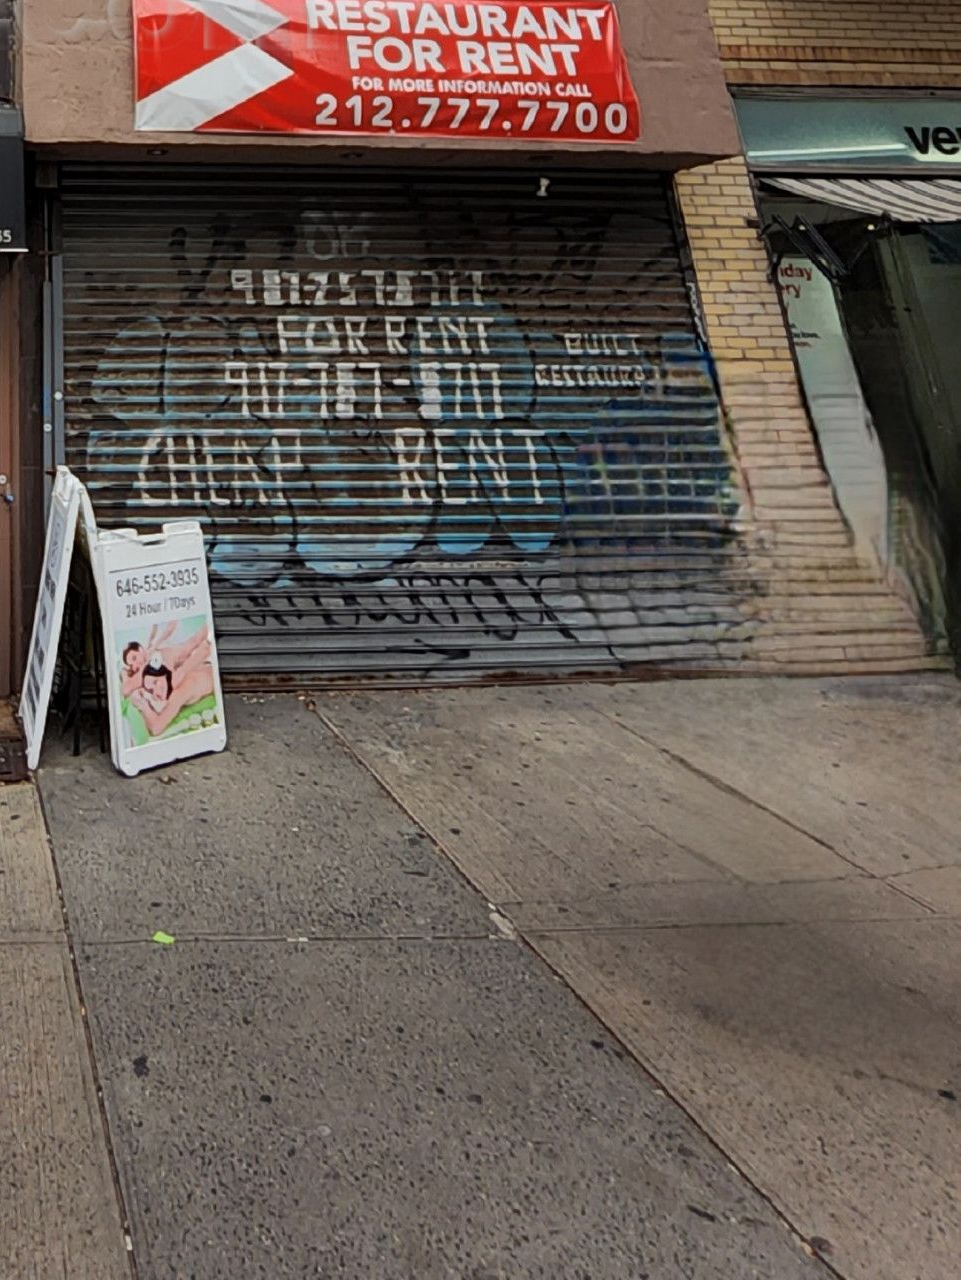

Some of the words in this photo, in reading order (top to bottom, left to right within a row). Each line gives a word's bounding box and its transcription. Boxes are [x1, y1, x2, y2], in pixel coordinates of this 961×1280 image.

[346, 35, 444, 74] FOR
[457, 40, 581, 77] RENT
[352, 76, 385, 92] FOR
[388, 77, 435, 94] MORE
[438, 79, 552, 98] INFORMATION
[555, 81, 592, 98] CALL
[315, 92, 629, 135] 212.777.7700
[903, 126, 961, 156] ve
[276, 314, 370, 355] FOR
[384, 315, 495, 356] RENT
[393, 427, 547, 506] RENT
[116, 567, 199, 596] 646-552-3935
[139, 602, 162, 617] Hour
